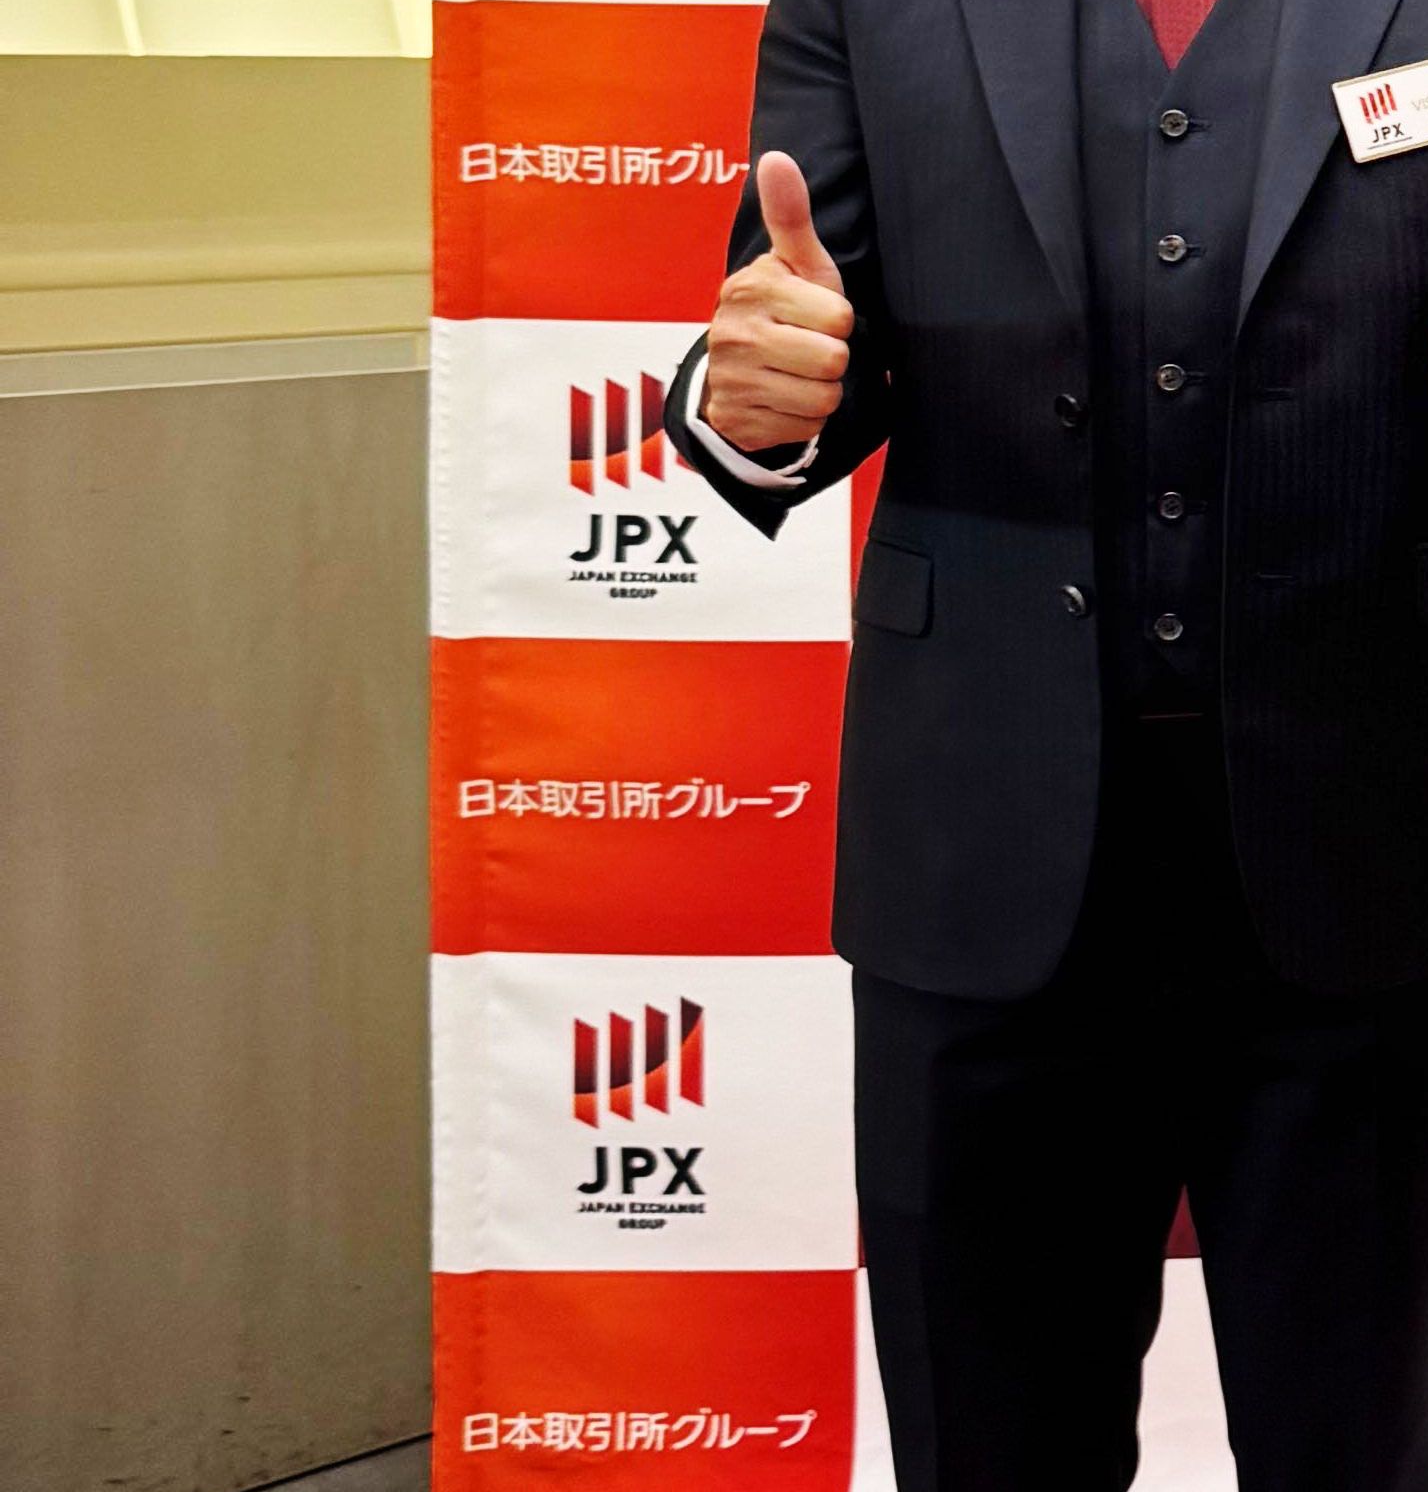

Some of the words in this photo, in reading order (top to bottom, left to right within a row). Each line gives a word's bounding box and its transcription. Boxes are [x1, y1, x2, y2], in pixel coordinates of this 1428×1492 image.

[1373, 123, 1405, 143] JPX
[569, 514, 697, 564] JPX
[567, 570, 617, 584] JAPAN
[619, 570, 698, 584] EXCHANGE
[608, 586, 658, 600] GROUP
[460, 778, 810, 819] 日本取引所グループ
[577, 1146, 705, 1196] JPX
[576, 1201, 626, 1215] JAPAN
[628, 1201, 707, 1215] EXCHANGE
[617, 1218, 668, 1230] GROUP
[464, 1410, 814, 1451] 日本取引所グループ
